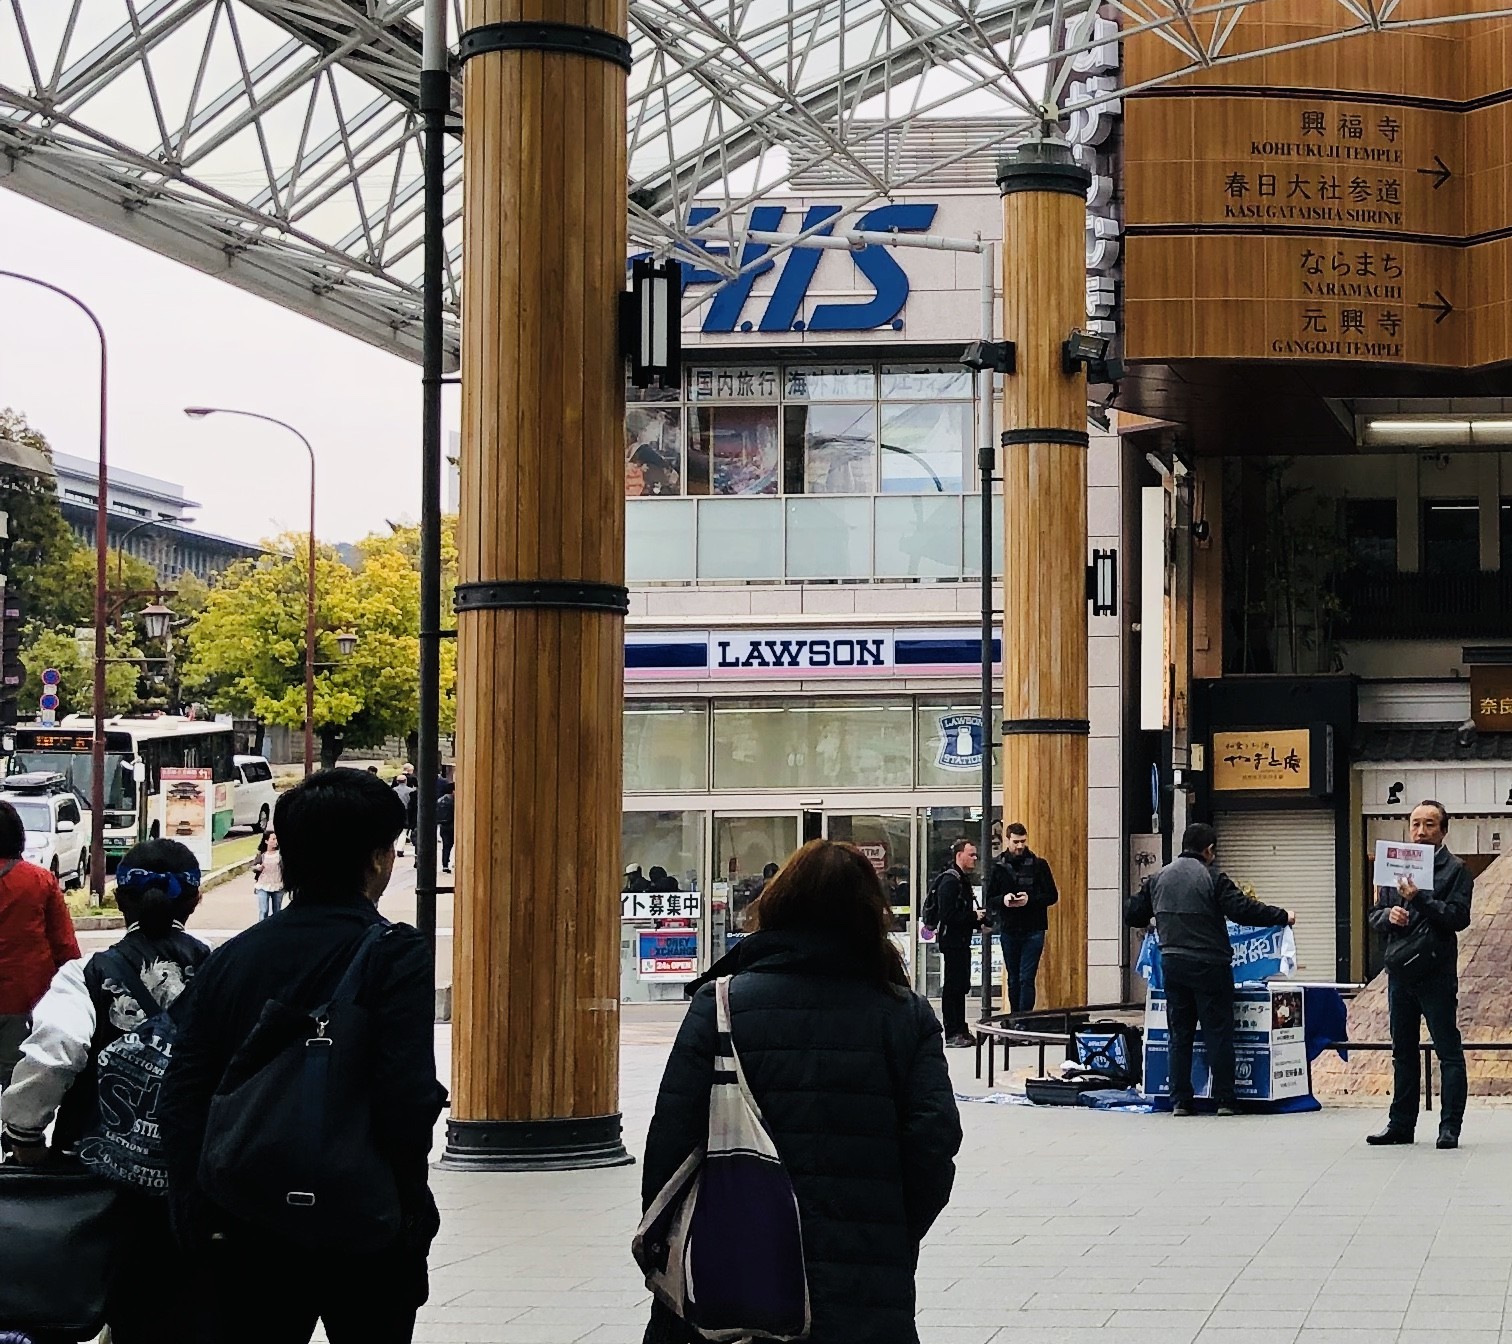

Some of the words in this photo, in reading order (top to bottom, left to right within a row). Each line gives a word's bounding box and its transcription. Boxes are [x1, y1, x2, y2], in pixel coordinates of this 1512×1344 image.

[1301, 111, 1401, 143] 興福寺
[1250, 141, 1340, 160] KOHFUKUJI
[1346, 146, 1402, 163] TEMPLE
[1224, 171, 1402, 205] 春日大社参道
[1225, 204, 1343, 223] KASUGATAISHA
[1346, 208, 1402, 225] SHRINE
[1301, 249, 1402, 280] ならまち
[1302, 281, 1402, 299] NARAMACHI
[1301, 309, 1402, 337] 元興寺
[1272, 339, 1341, 355] GANGOJI
[1346, 342, 1403, 357] TEMPLE
[695, 369, 777, 398] 国内旅行
[718, 640, 884, 667] LAWSON
